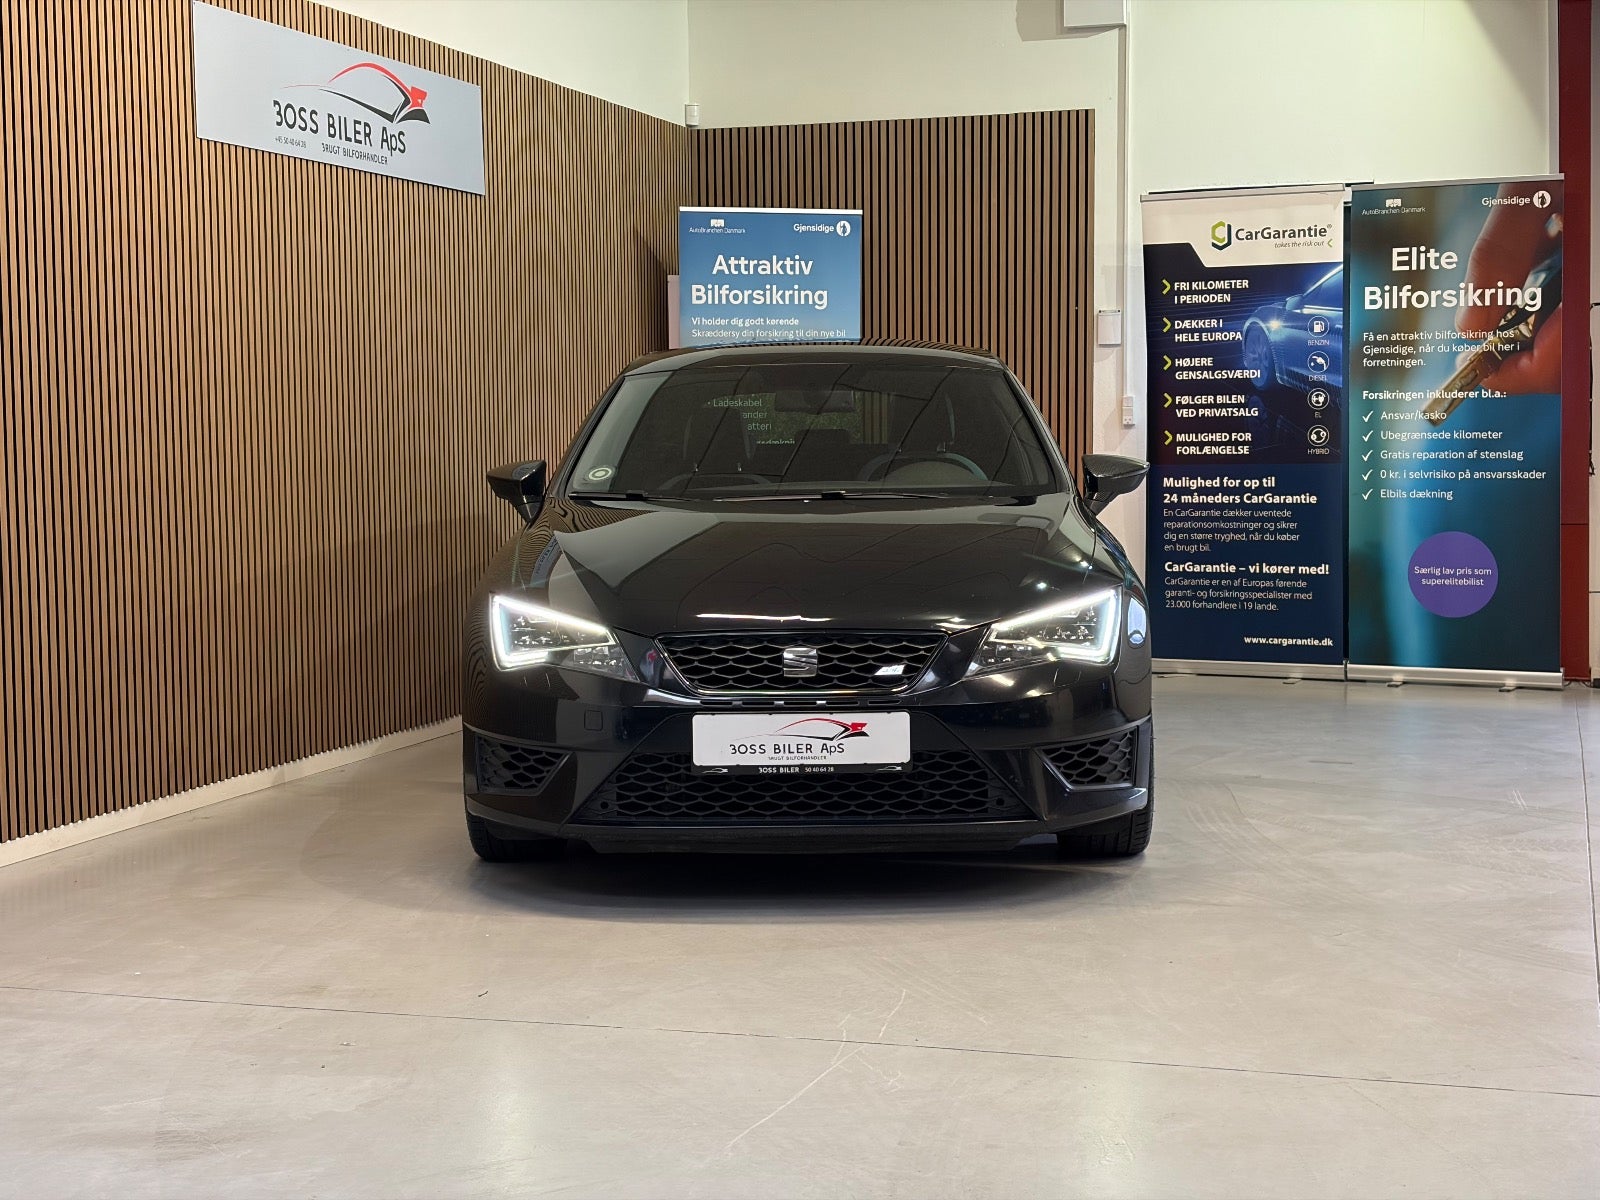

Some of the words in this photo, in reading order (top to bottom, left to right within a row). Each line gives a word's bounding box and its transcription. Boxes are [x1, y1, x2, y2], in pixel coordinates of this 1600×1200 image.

[328, 113, 372, 147] BILER
[381, 127, 406, 156] ApS
[342, 147, 388, 165] BILFORHANDLER
[1482, 196, 1531, 206] Gjensidige
[793, 223, 834, 234] Gjensidige
[712, 254, 814, 275] Attraktiv
[1392, 246, 1458, 272] Elite
[1174, 282, 1190, 292] FRI
[1192, 280, 1249, 290] KILOMETER
[692, 285, 828, 310] Bilforsikring
[1175, 296, 1177, 304] I
[1180, 294, 1231, 304] PERIODEN
[1364, 281, 1542, 312] Bilforsikring
[731, 318, 743, 327] dig
[745, 318, 764, 327] godt
[766, 318, 799, 326] kørende
[1174, 320, 1218, 329] DÆKKER
[1220, 319, 1223, 327] I
[692, 330, 740, 339] Skræddersy
[756, 330, 794, 339] forsikring
[1175, 333, 1200, 342] HELE
[1202, 332, 1242, 341] EUROPA
[1363, 332, 1374, 341] Få
[1391, 332, 1433, 341] attraktiv
[1435, 330, 1494, 341] bilforsikring
[1496, 329, 1515, 339] hos
[1363, 345, 1416, 356] Gjensidige,
[1419, 344, 1435, 353] når
[1438, 344, 1450, 352] du
[1452, 343, 1481, 352] køber
[1483, 343, 1496, 352] bil
[1498, 343, 1515, 352] her
[1175, 358, 1213, 367] HØJERE
[1363, 358, 1426, 369] forretningen.
[1175, 370, 1260, 380] GENSALGSVÆRDI
[1176, 395, 1214, 405] FØLGER
[1217, 395, 1245, 404] BILEN
[1363, 391, 1424, 400] Forsikringen
[1426, 390, 1479, 399] inkluderer
[1482, 390, 1507, 399] bl.a.:
[713, 399, 762, 407] Ladeskabel
[1176, 409, 1197, 418] VED
[1199, 408, 1259, 418] PRIVATSALG
[1381, 411, 1447, 421] Ansvar/kasko
[1176, 433, 1230, 442] MULIGHED
[1232, 433, 1252, 441] FOR
[1381, 430, 1451, 441] Ubegrænsede
[1454, 430, 1502, 439] kilometer
[1177, 446, 1249, 455] FORLÆNGELSE
[1381, 450, 1410, 459] Gratis
[1412, 451, 1465, 461] reparation
[1468, 450, 1478, 459] af
[1480, 450, 1524, 461] stenslag
[1381, 471, 1387, 479] 0
[1389, 470, 1401, 479] kr.
[1409, 470, 1456, 479] selvrisiko
[1459, 469, 1470, 481] på
[1474, 470, 1546, 480] ansvarsskader
[1163, 477, 1220, 489] Mulighed
[1223, 477, 1239, 488] for
[1244, 479, 1260, 489] op
[1263, 476, 1275, 488] til
[1164, 494, 1179, 504] 24
[1181, 493, 1241, 504] måneders
[1243, 493, 1317, 504] CarGarantie
[1381, 489, 1407, 499] Elbils
[1410, 489, 1453, 501] dækning
[1164, 509, 1174, 517] En
[1175, 509, 1221, 517] CarGarantie
[1222, 509, 1252, 517] dækker
[1254, 510, 1292, 518] uventede
[1164, 521, 1262, 530] reparationsomkostninger
[1263, 522, 1275, 530] og
[1277, 521, 1298, 529] sikrer
[1164, 532, 1177, 542] dig
[1214, 533, 1248, 543] tryghed,
[1249, 533, 1262, 541] når
[1264, 533, 1275, 541] du
[1277, 533, 1300, 542] køber
[1176, 543, 1198, 553] brugt
[1199, 543, 1211, 552] bil.
[1164, 562, 1236, 573] CarGarantie
[1249, 563, 1259, 573] vi
[1263, 563, 1295, 574] kører
[1298, 564, 1329, 574] med!
[1414, 566, 1441, 576] Særlig
[1442, 567, 1455, 575] lav
[1457, 567, 1472, 576] pris
[1165, 578, 1211, 586] CarGarantie
[1234, 579, 1241, 587] af
[1242, 579, 1274, 589] Europas
[1276, 580, 1307, 588] førende
[1165, 590, 1196, 599] garanti-
[1209, 590, 1292, 600] forsikringsspecialister
[1294, 592, 1312, 600] med
[1166, 601, 1191, 609] 23.000
[1192, 601, 1238, 610] forhandlere
[1244, 602, 1253, 610] 19
[1255, 602, 1279, 611] lande.
[1244, 636, 1333, 647] www.cargarantie.dk
[774, 744, 813, 754] BILER
[821, 743, 845, 756] ApS
